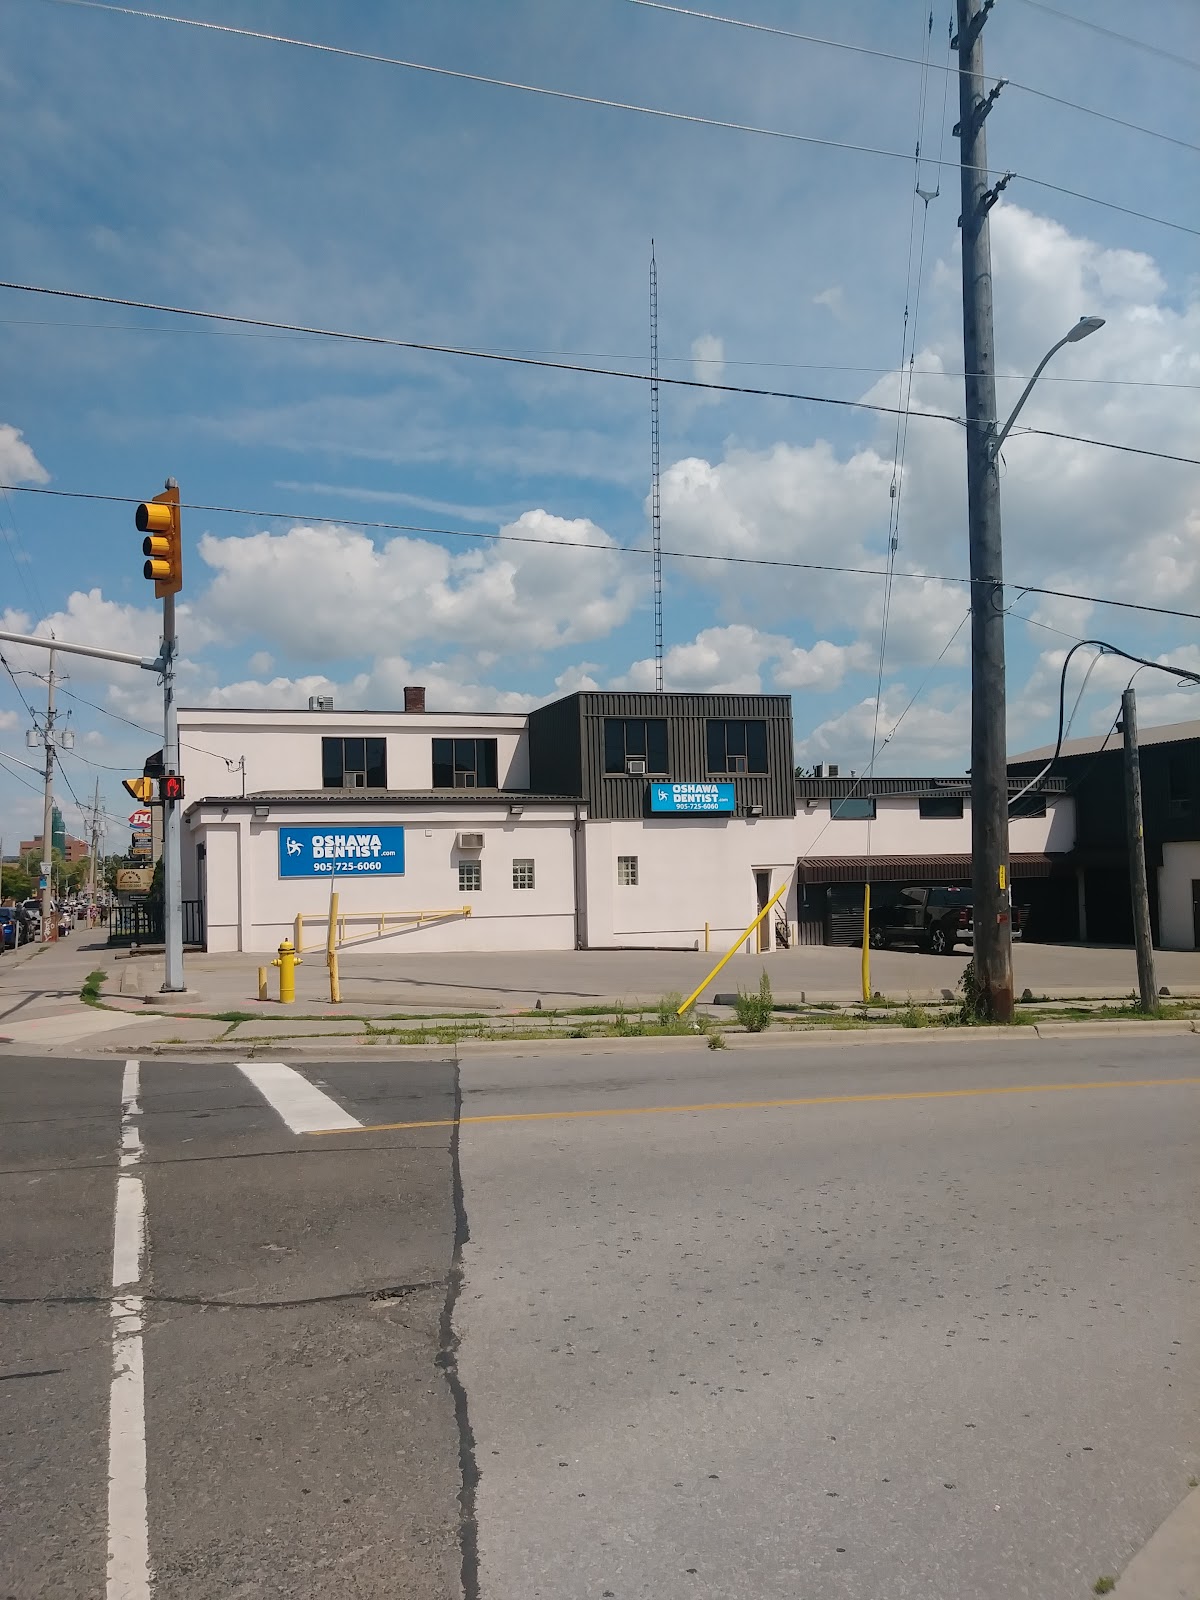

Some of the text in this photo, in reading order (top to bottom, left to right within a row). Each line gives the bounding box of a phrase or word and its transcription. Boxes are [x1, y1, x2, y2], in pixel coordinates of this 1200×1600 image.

[672, 784, 718, 793] OSHAWA
[134, 814, 151, 824] DQ
[312, 834, 382, 846] OSHAWA
[314, 862, 381, 871] 905-725-6060
